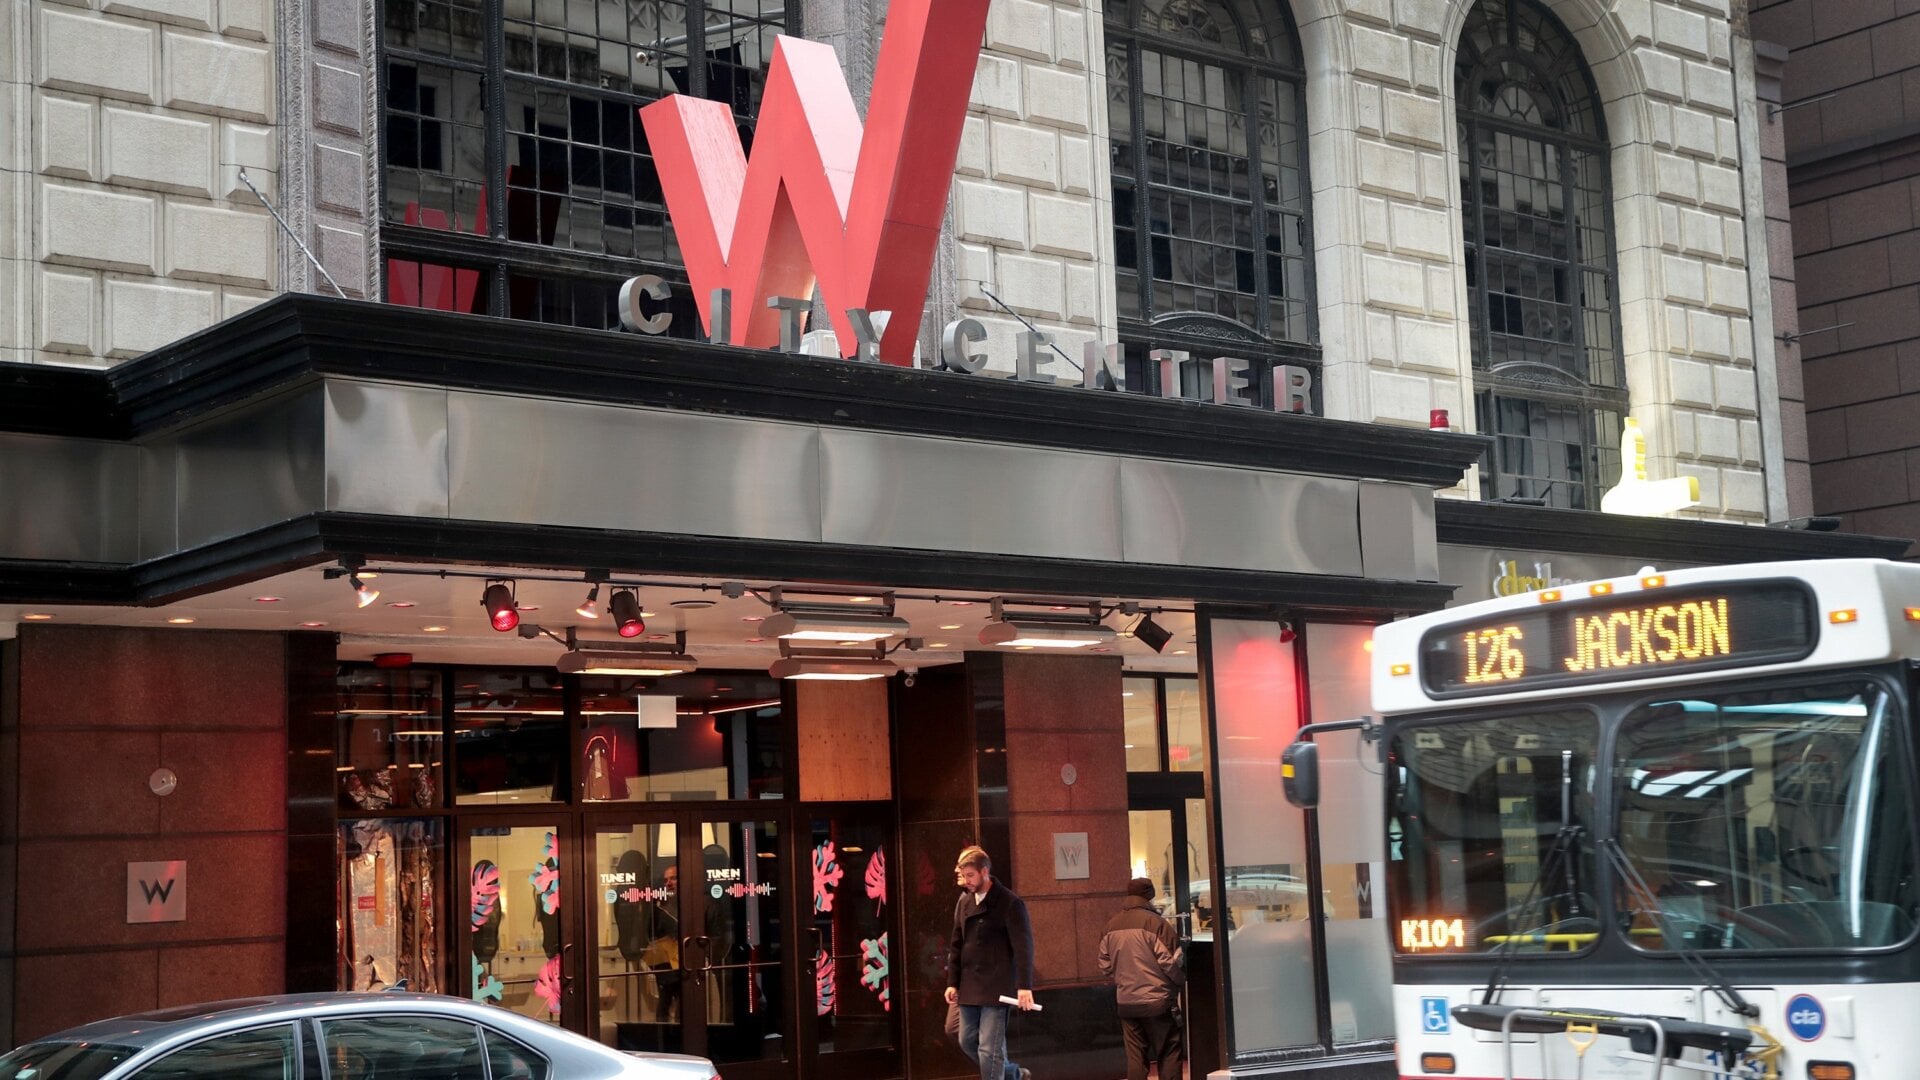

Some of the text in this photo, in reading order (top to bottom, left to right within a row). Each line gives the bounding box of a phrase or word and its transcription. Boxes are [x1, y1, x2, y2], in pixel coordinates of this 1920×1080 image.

[639, 0, 992, 368] W
[618, 274, 1313, 415] CITY CENTER
[1464, 598, 1730, 683] 126 JACKSON
[1060, 845, 1082, 868] W
[600, 872, 636, 883] TUNE IN
[706, 868, 741, 878] TUNE IN
[139, 879, 175, 905] W
[1401, 919, 1465, 947] K104
[1790, 1012, 1820, 1026] cta
